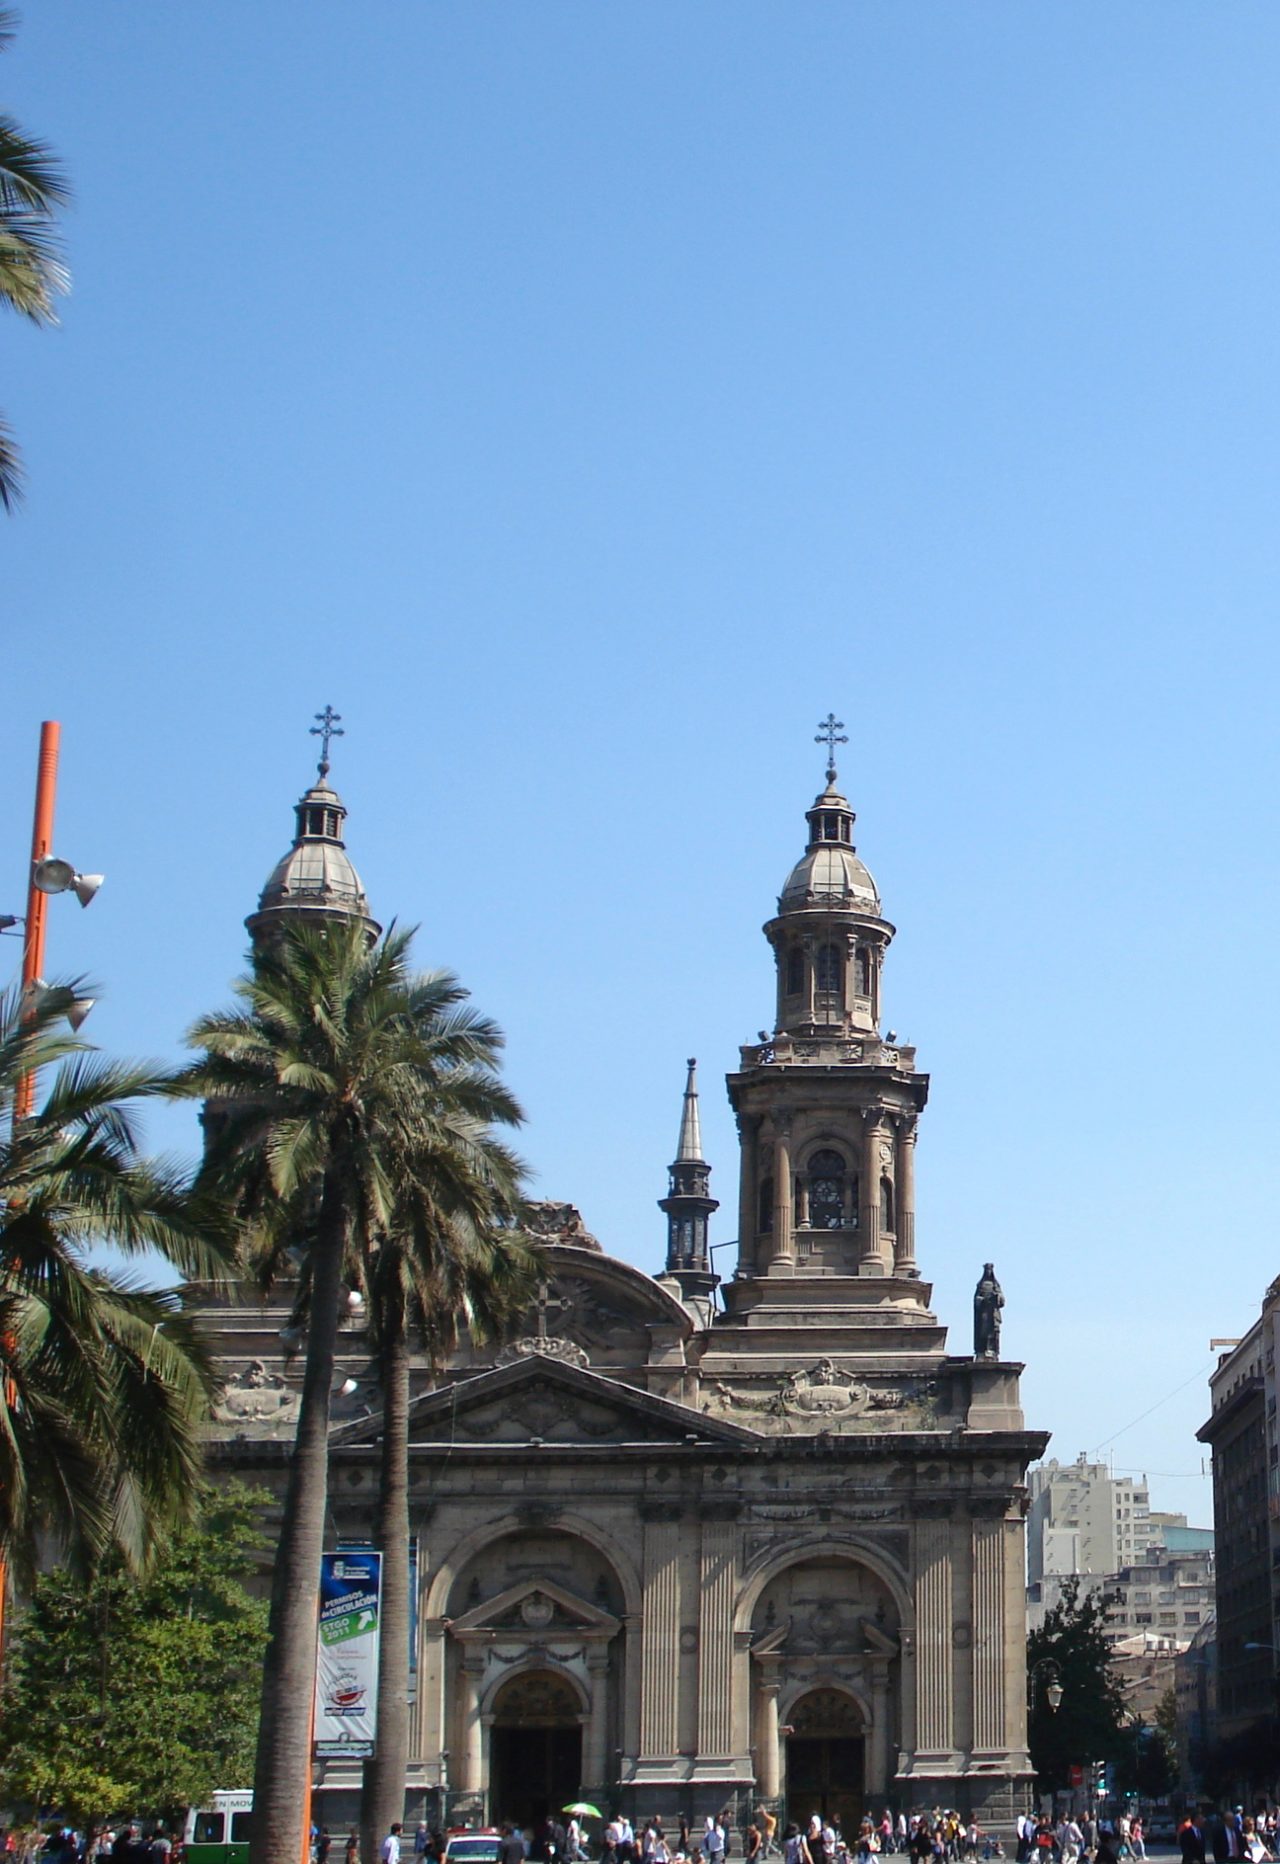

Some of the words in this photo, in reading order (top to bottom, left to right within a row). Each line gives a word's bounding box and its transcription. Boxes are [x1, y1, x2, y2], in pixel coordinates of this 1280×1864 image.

[325, 1590, 363, 1608] PERMISOS
[322, 1618, 349, 1632] STGO
[327, 1627, 349, 1640] 2011
